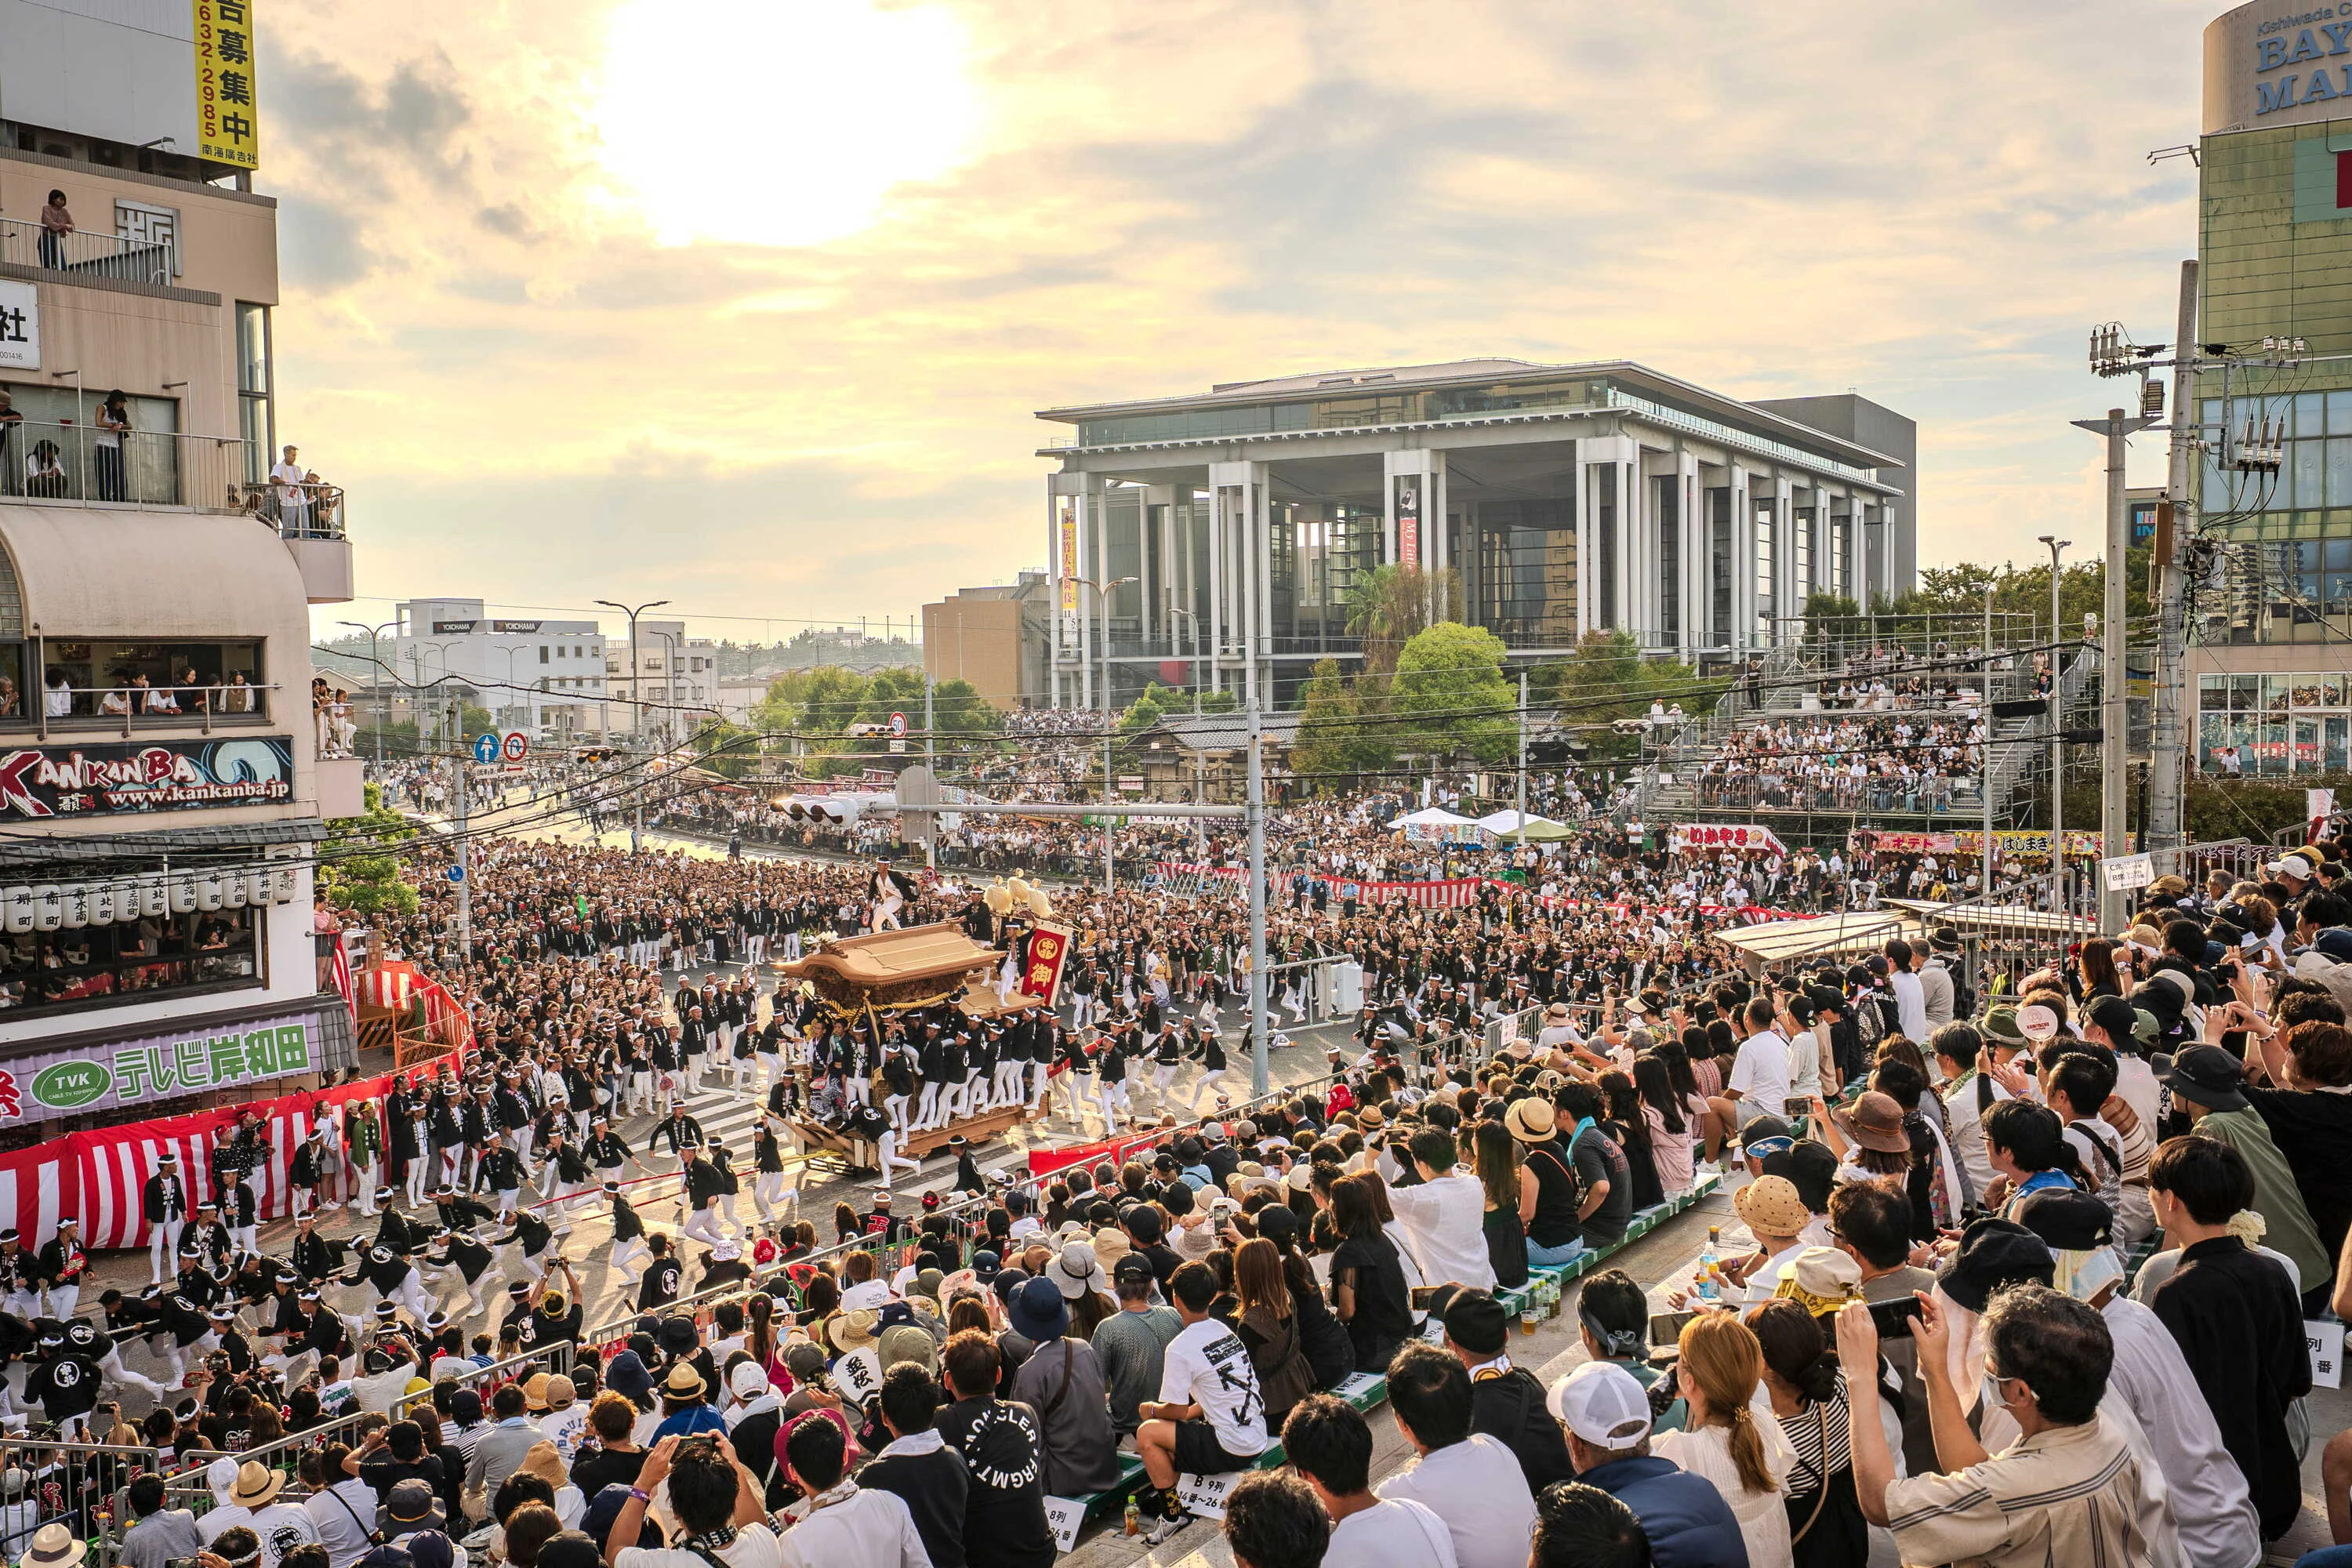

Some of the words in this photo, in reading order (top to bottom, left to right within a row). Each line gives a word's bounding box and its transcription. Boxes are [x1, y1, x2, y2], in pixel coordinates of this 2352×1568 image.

[2258, 7, 2334, 36] Kishiwada
[2256, 20, 2352, 73] BAY
[199, 0, 217, 138] 632-2985
[893, 720, 903, 731] 50
[108, 782, 290, 807] www.kankanba.jp
[1689, 826, 1749, 847] いかやき
[2002, 835, 2049, 853] はしまき
[114, 1022, 310, 1101] テレビ岸和田
[55, 1072, 90, 1090] TVK
[557, 1417, 587, 1447] BRUI
[976, 1457, 1038, 1490] FRGMT
